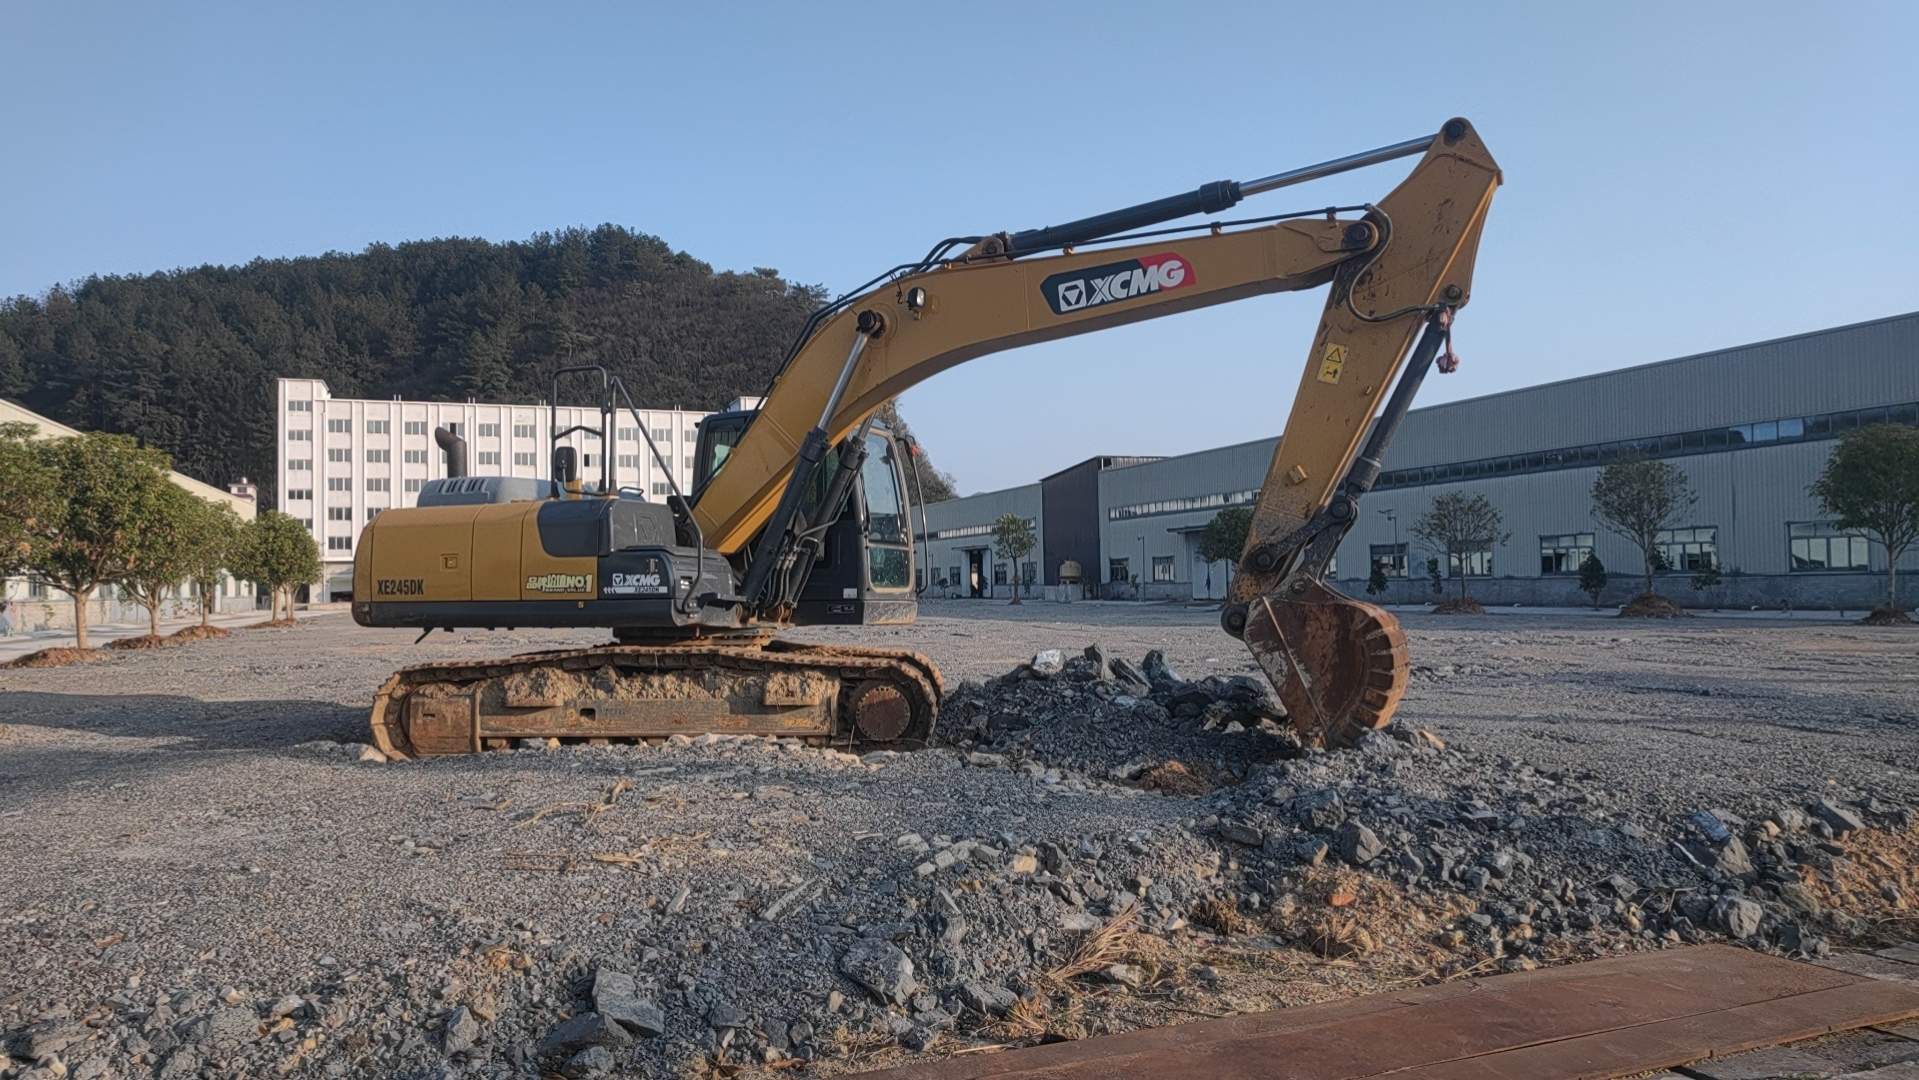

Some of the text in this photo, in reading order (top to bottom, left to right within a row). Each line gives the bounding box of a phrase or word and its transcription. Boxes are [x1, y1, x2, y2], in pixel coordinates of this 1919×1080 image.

[1087, 259, 1185, 306] XCMG
[377, 579, 424, 595] XE245DK
[624, 574, 660, 586] XCMG
